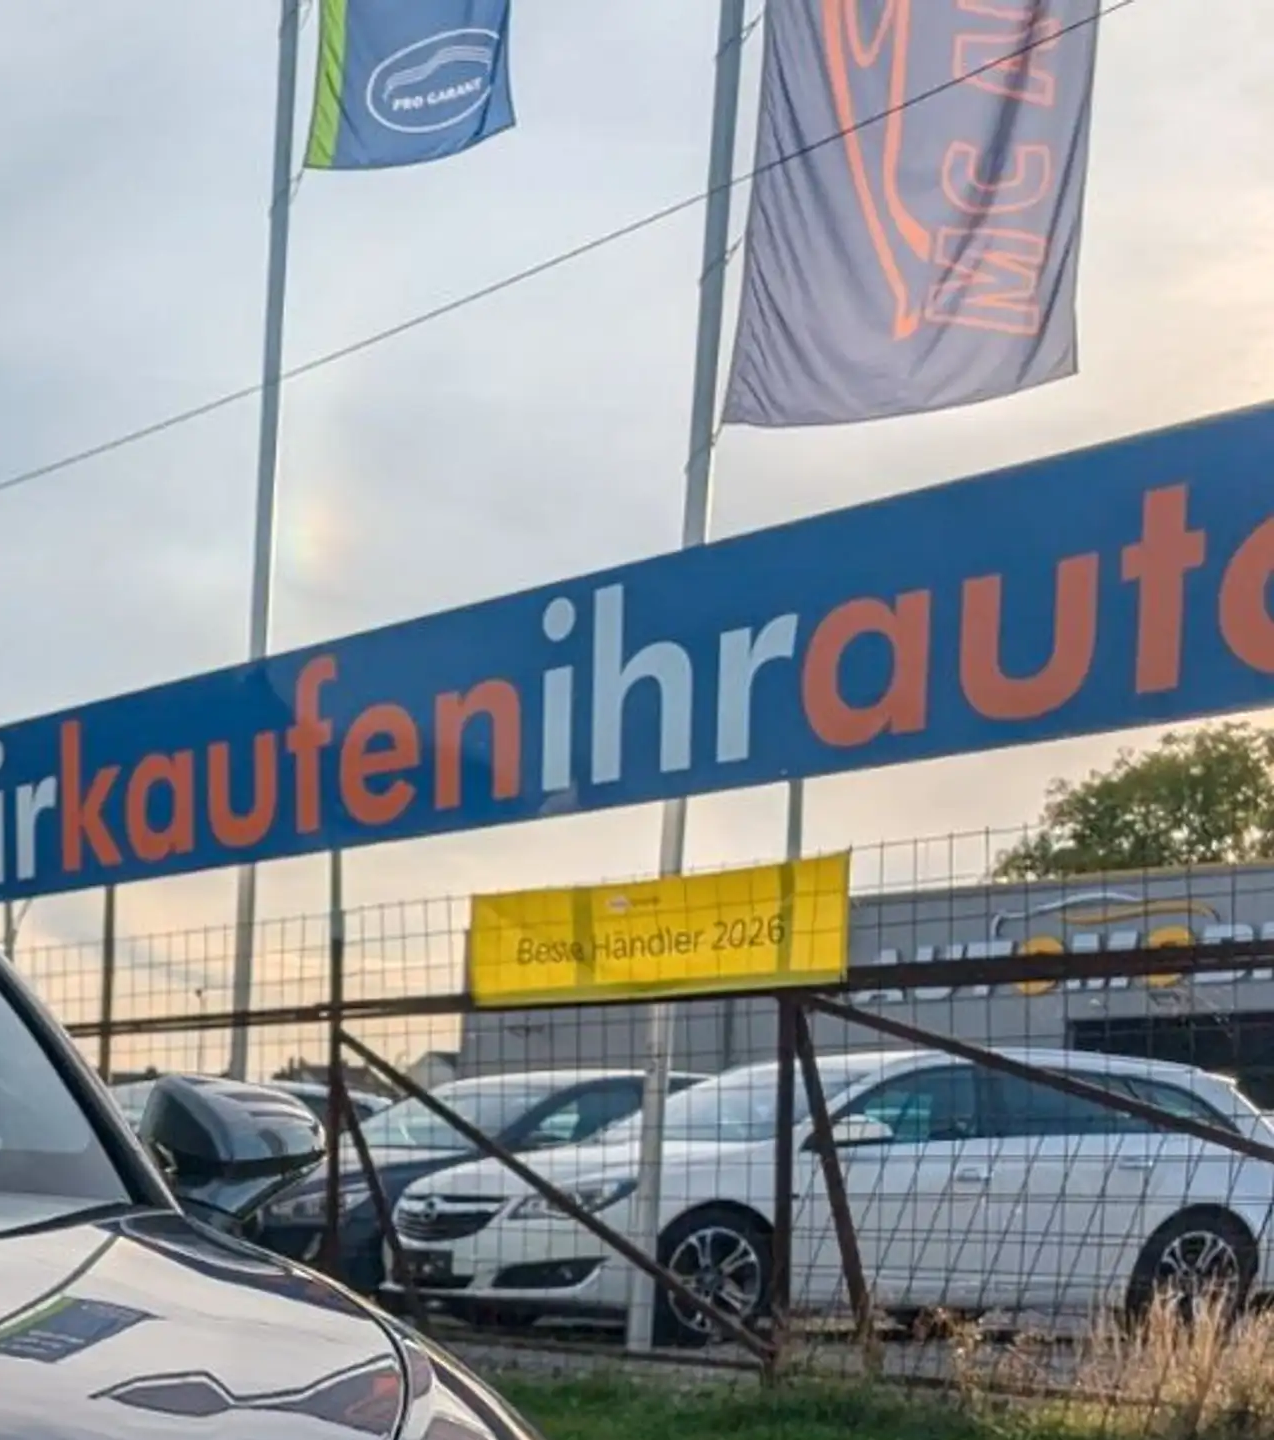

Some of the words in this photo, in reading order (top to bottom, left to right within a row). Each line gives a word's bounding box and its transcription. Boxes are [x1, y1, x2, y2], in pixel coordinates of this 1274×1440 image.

[391, 95, 424, 112] PRO
[924, 140, 1052, 337] MC
[591, 925, 706, 962] Händler
[710, 914, 786, 951] 2026
